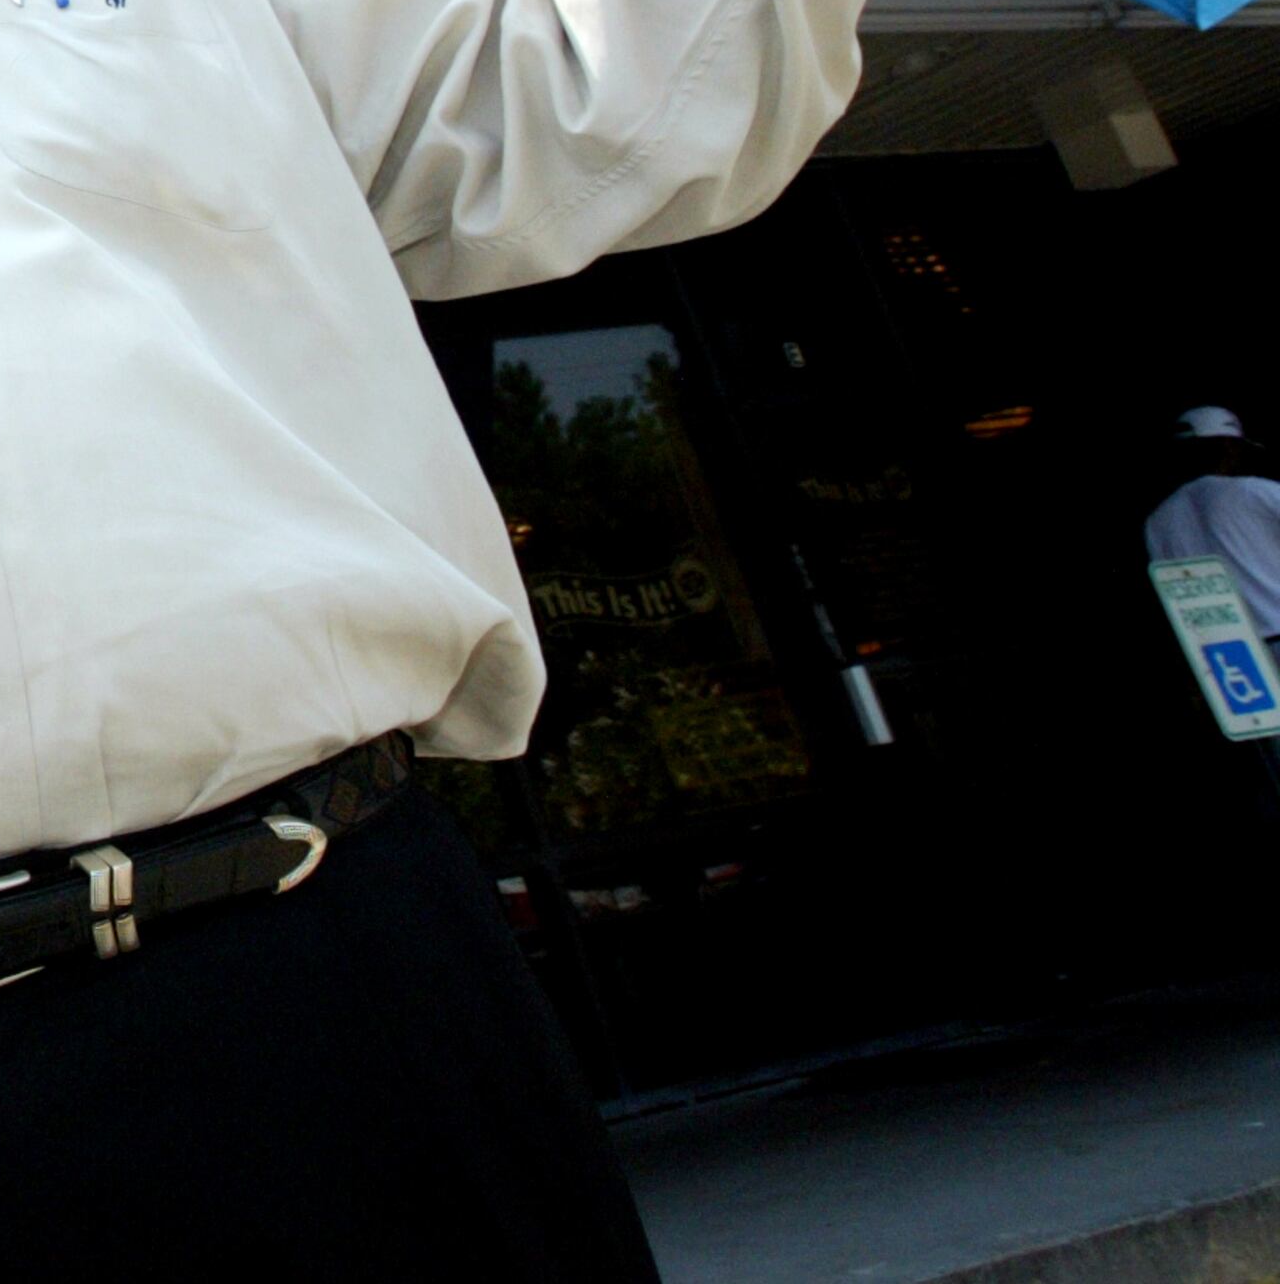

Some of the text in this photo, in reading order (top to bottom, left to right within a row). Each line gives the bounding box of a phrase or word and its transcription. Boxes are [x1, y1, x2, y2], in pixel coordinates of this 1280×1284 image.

[531, 579, 605, 619] This
[606, 584, 640, 619] Is
[637, 580, 676, 617] It!
[1178, 602, 1241, 627] PARKING
